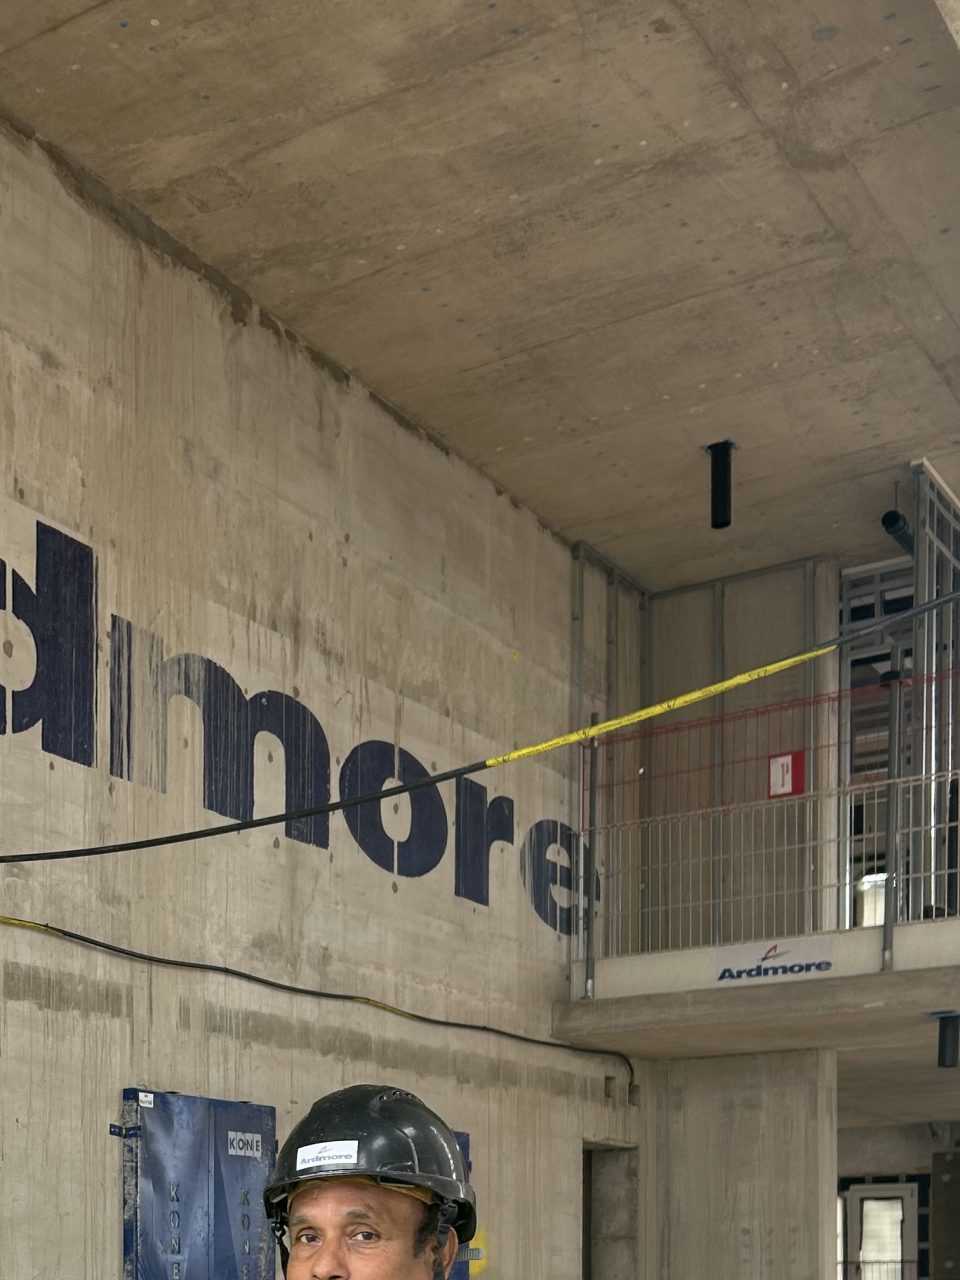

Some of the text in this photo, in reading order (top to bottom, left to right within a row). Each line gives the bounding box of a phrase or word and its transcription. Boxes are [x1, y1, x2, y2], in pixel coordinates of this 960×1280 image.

[717, 960, 833, 982] Ardmore
[230, 1137, 261, 1152] KONE
[300, 1154, 353, 1165] Ardmore
